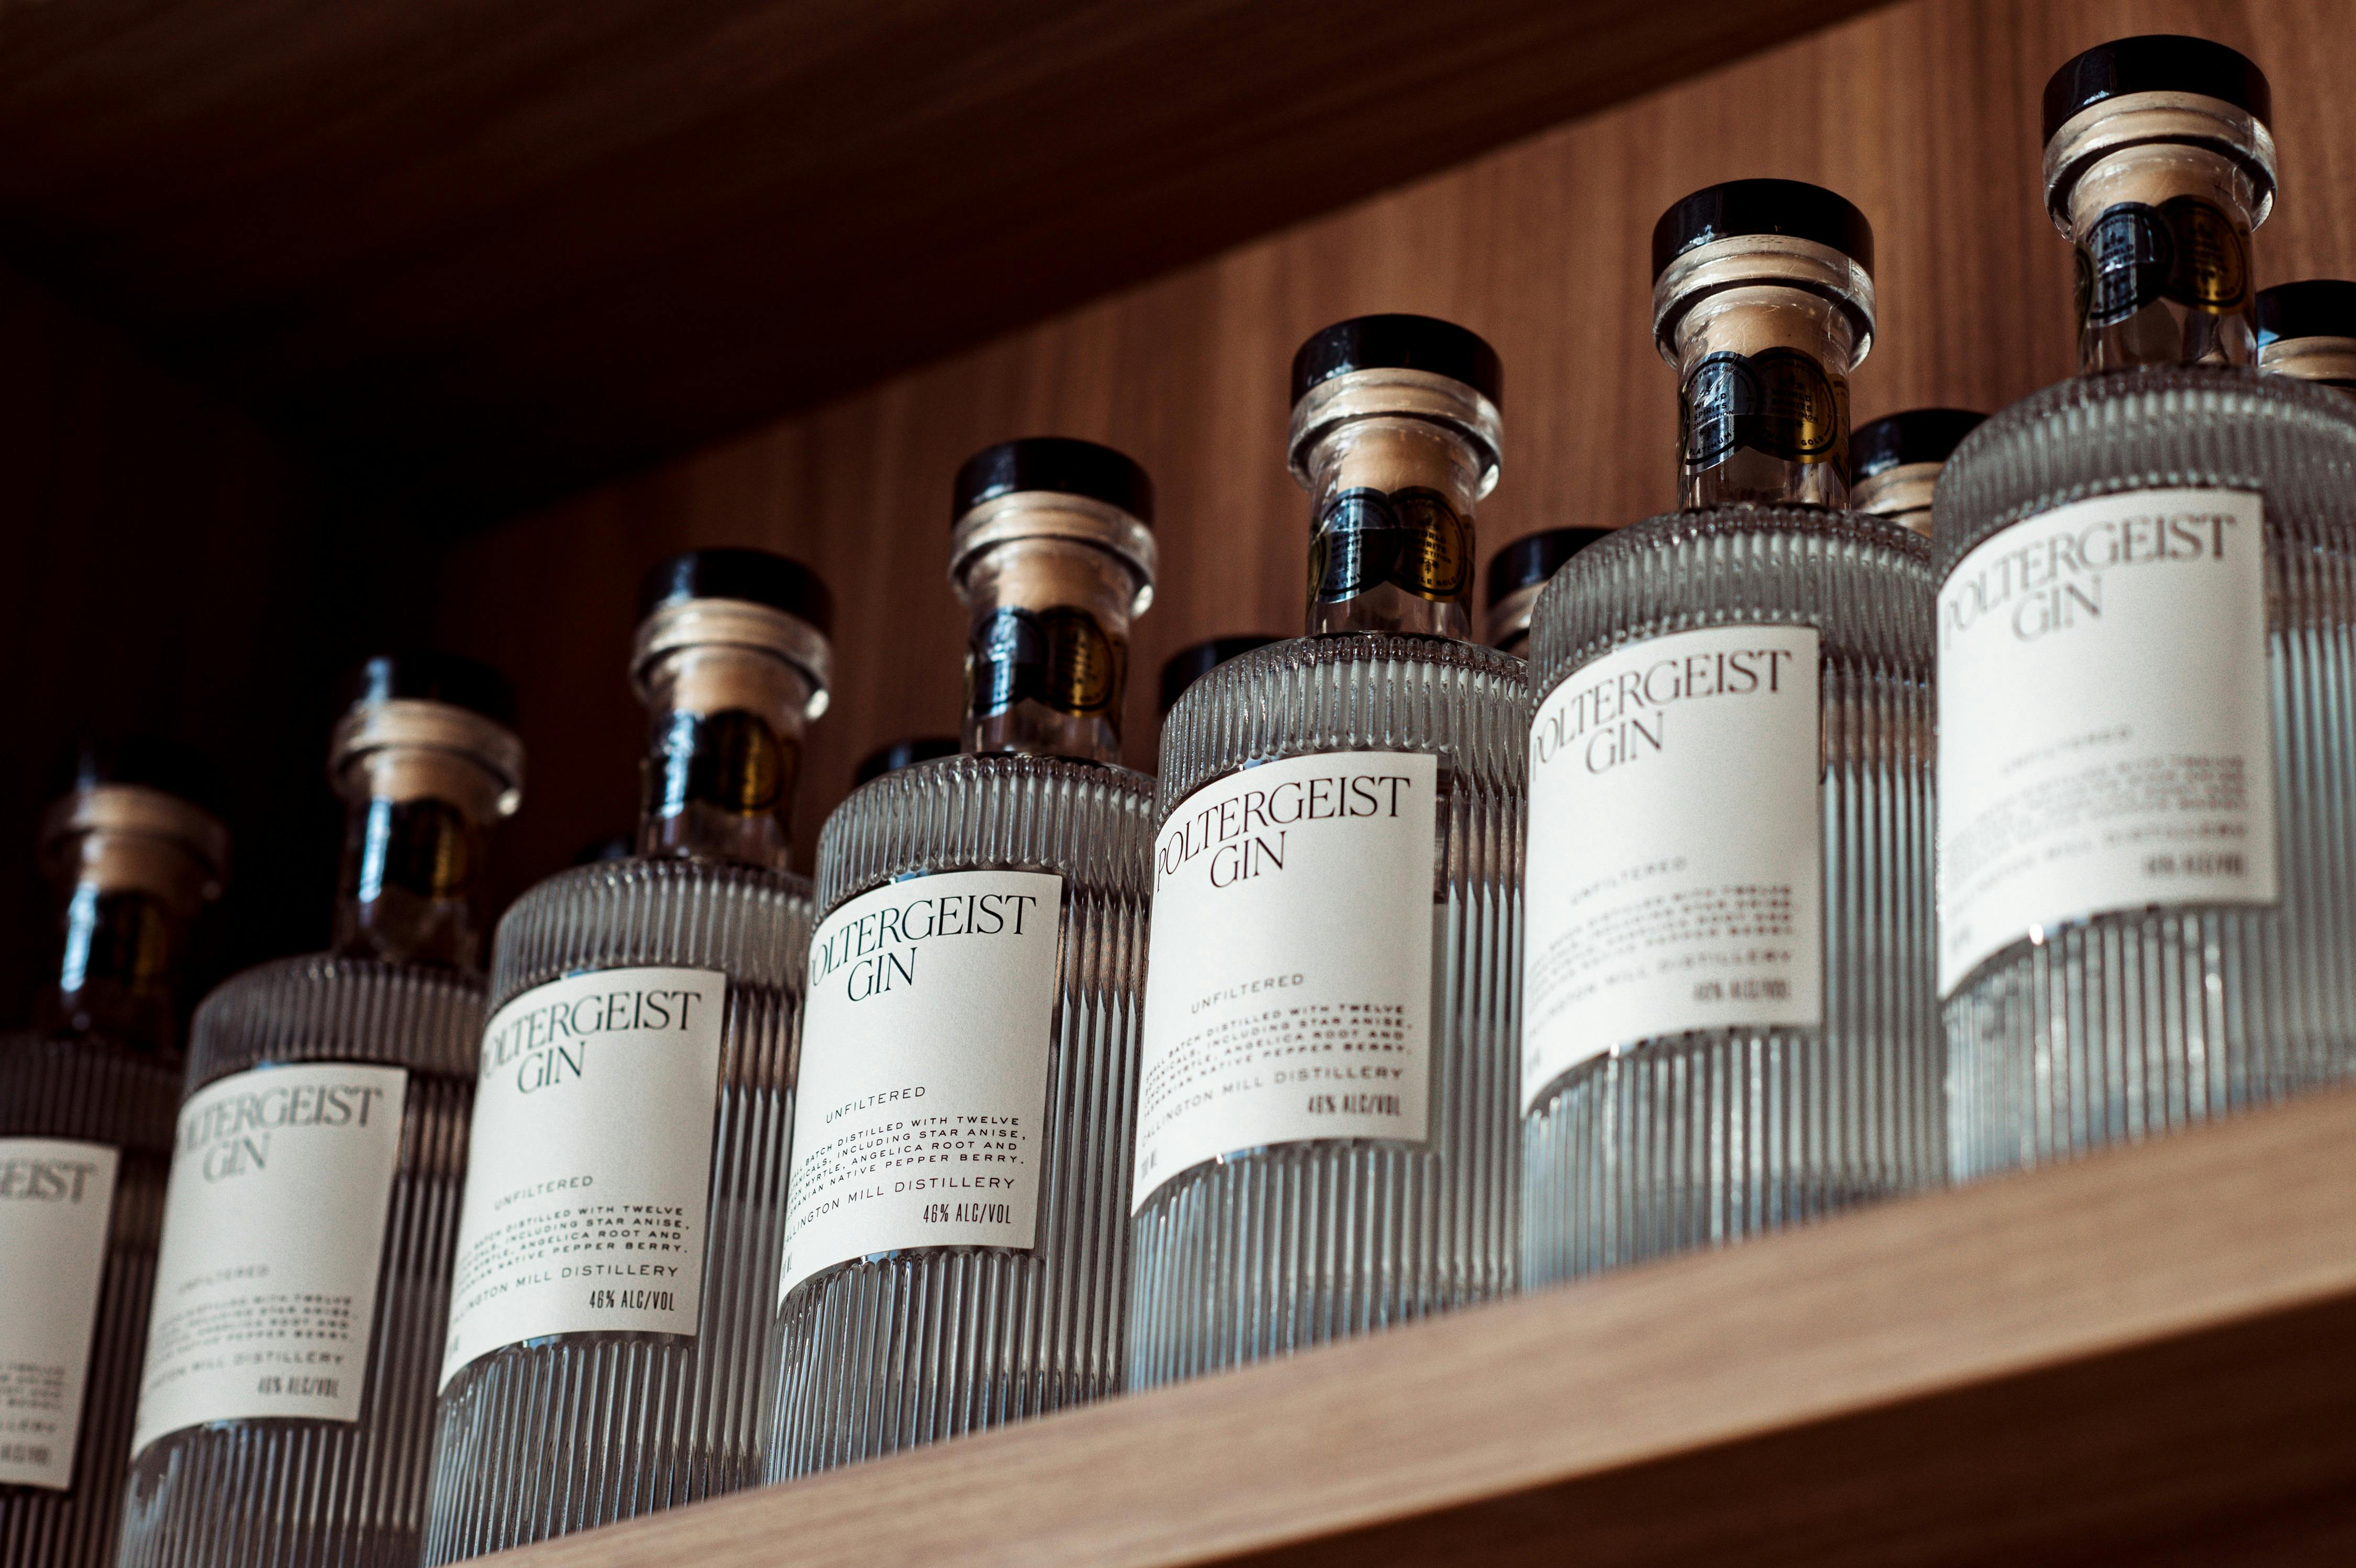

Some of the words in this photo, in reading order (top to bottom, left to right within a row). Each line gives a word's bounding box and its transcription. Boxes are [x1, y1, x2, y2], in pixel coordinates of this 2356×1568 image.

[1694, 403, 1727, 421] SPIRITS
[1801, 435, 1824, 446] GOLD
[2012, 575, 2103, 643] GIN
[1585, 710, 1664, 775] GIN
[1157, 775, 1412, 893] POLTERGEIST
[1210, 831, 1287, 888] GIN
[812, 894, 1037, 986] OLTERGEIST
[847, 946, 918, 1002] GIN
[1191, 973, 1305, 1015] UNFILTERED
[481, 989, 702, 1079] OLTERGEIST
[517, 1040, 586, 1094] GIN
[1222, 1076, 1264, 1095] MILL
[1274, 1065, 1404, 1084] DISTILLERY
[826, 1086, 926, 1124] UNFILTERED
[805, 1143, 833, 1166] BATCH
[837, 1122, 904, 1147] DISTILLED
[911, 1117, 948, 1127] WITH
[957, 1116, 1019, 1126] TWELVE
[837, 1132, 911, 1159] INCLUDING
[919, 1129, 959, 1139] STAR
[967, 1129, 1026, 1141] ANISE,
[805, 1163, 846, 1188] MYRTLE,
[851, 1144, 923, 1165] ANGELICA
[931, 1141, 975, 1150] ROOT
[983, 1141, 1017, 1151] AND
[829, 1164, 876, 1186] NATIVE
[885, 1154, 949, 1169] PEPPER
[960, 1153, 1024, 1165] BERRY.
[493, 1175, 594, 1211] UNFILTERED
[577, 1206, 615, 1216] WITH
[623, 1205, 683, 1217] TWELVE
[784, 1197, 840, 1246] ALLINGTON
[848, 1185, 884, 1204] MILL
[894, 1177, 1015, 1193] DISTILLERY
[586, 1218, 625, 1227] STAR
[923, 1203, 949, 1224] 46%
[955, 1203, 1012, 1224] ALC/VOL
[519, 1231, 590, 1250] ANGELICA
[598, 1230, 641, 1239] ROOT
[648, 1230, 681, 1241] AND
[552, 1241, 615, 1254] PEPPER
[515, 1271, 552, 1287] MILL
[561, 1264, 679, 1278] DISTILLERY
[589, 1289, 615, 1309] 46%
[620, 1289, 674, 1311] ALC/VOL
